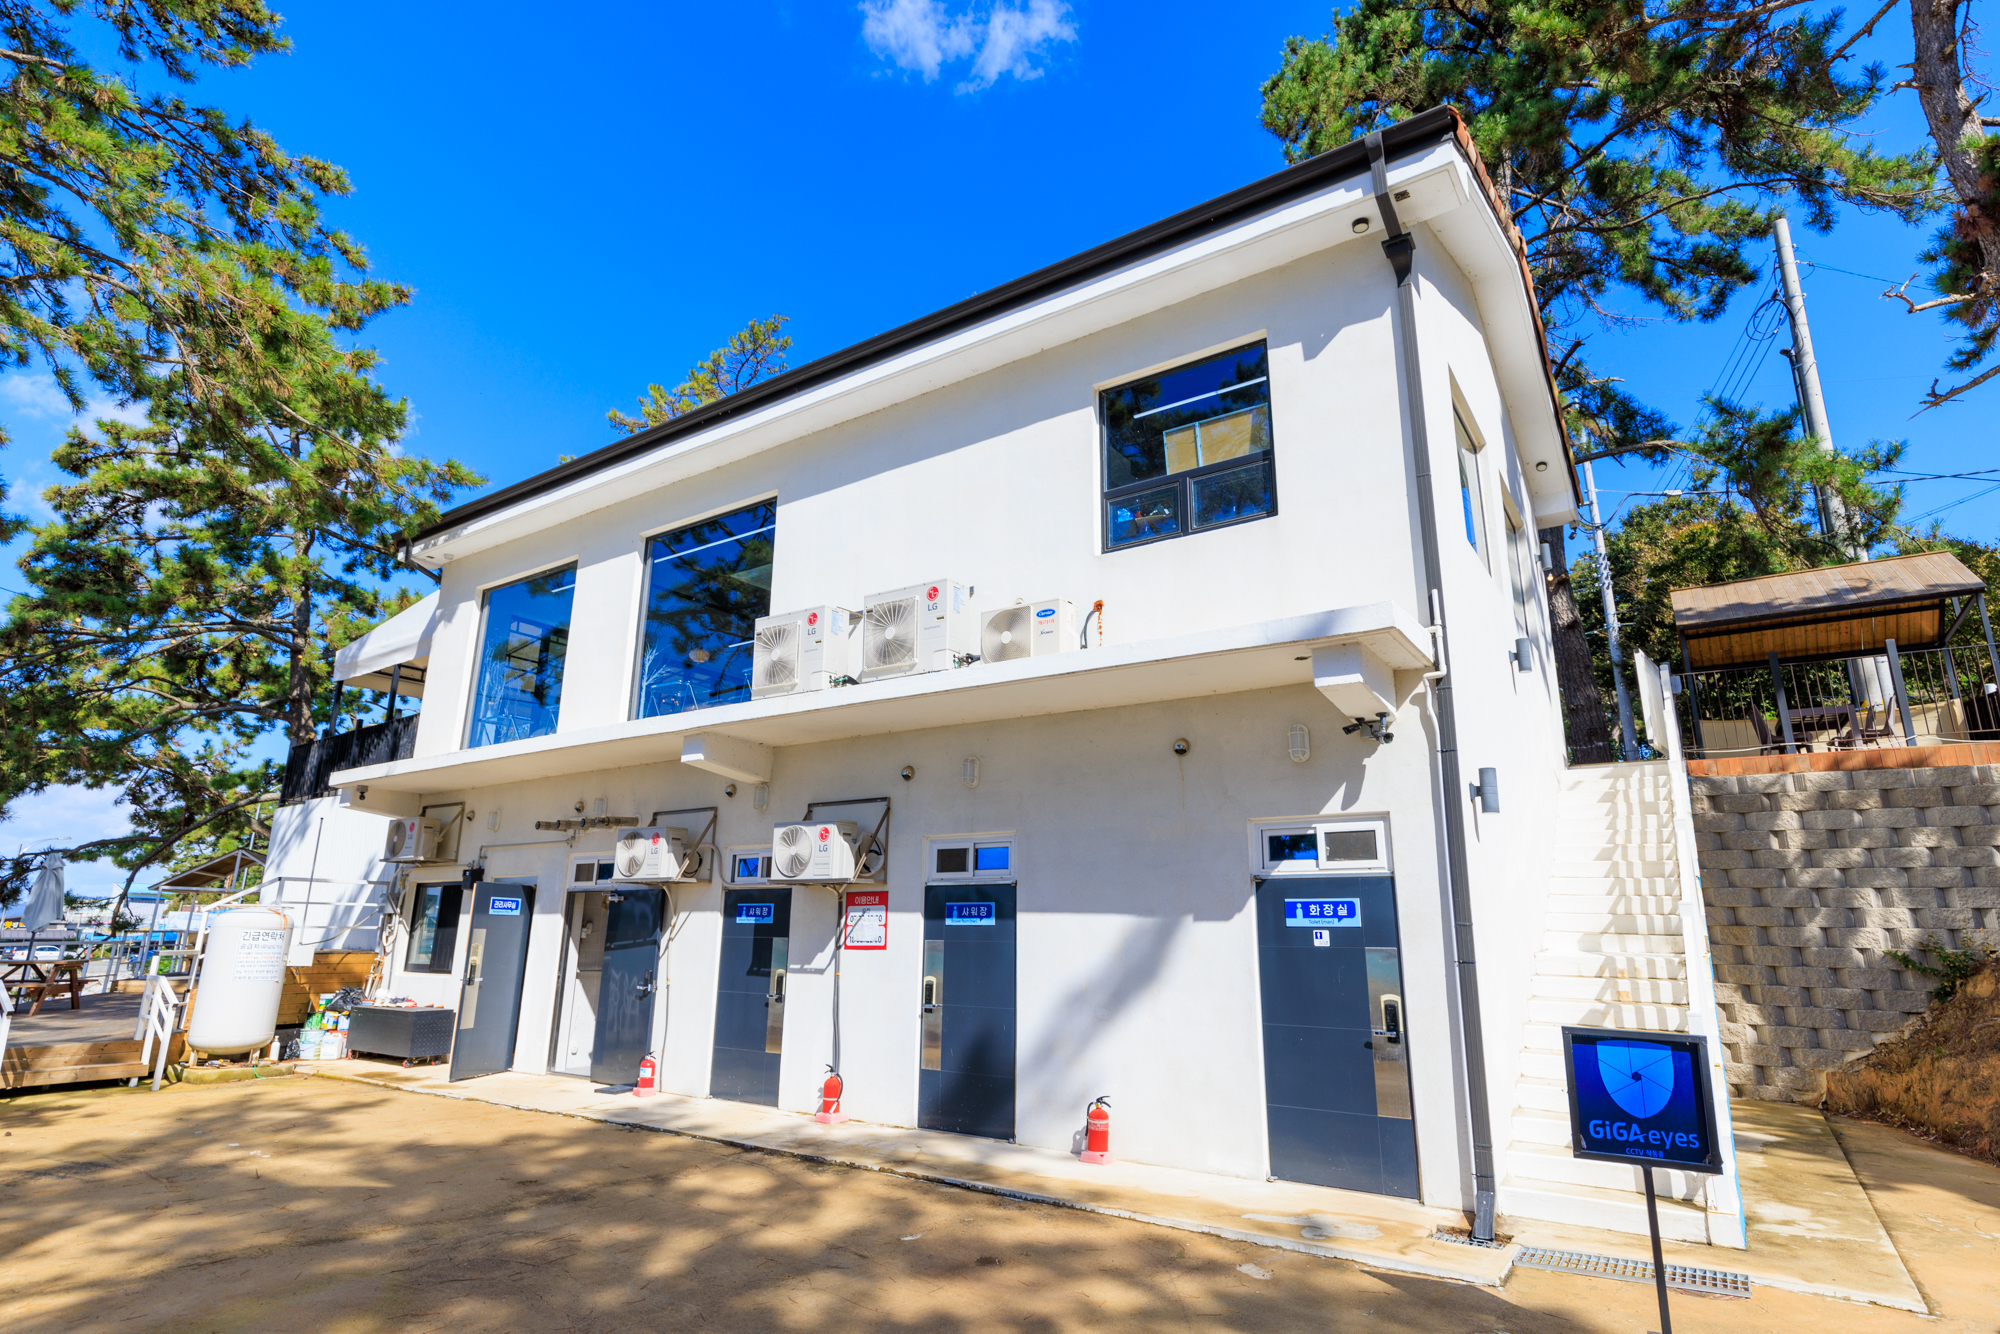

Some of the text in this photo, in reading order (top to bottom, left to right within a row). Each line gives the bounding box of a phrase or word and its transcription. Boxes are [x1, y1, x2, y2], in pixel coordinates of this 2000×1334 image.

[927, 602, 938, 612] LG
[807, 627, 816, 636] LG
[650, 847, 659, 855] LG
[818, 844, 828, 853] LG
[493, 900, 517, 910] 관리사무실
[854, 896, 880, 905] 이용안내
[1309, 904, 1348, 916] 화장실
[1625, 1147, 1644, 1156] CCTV
